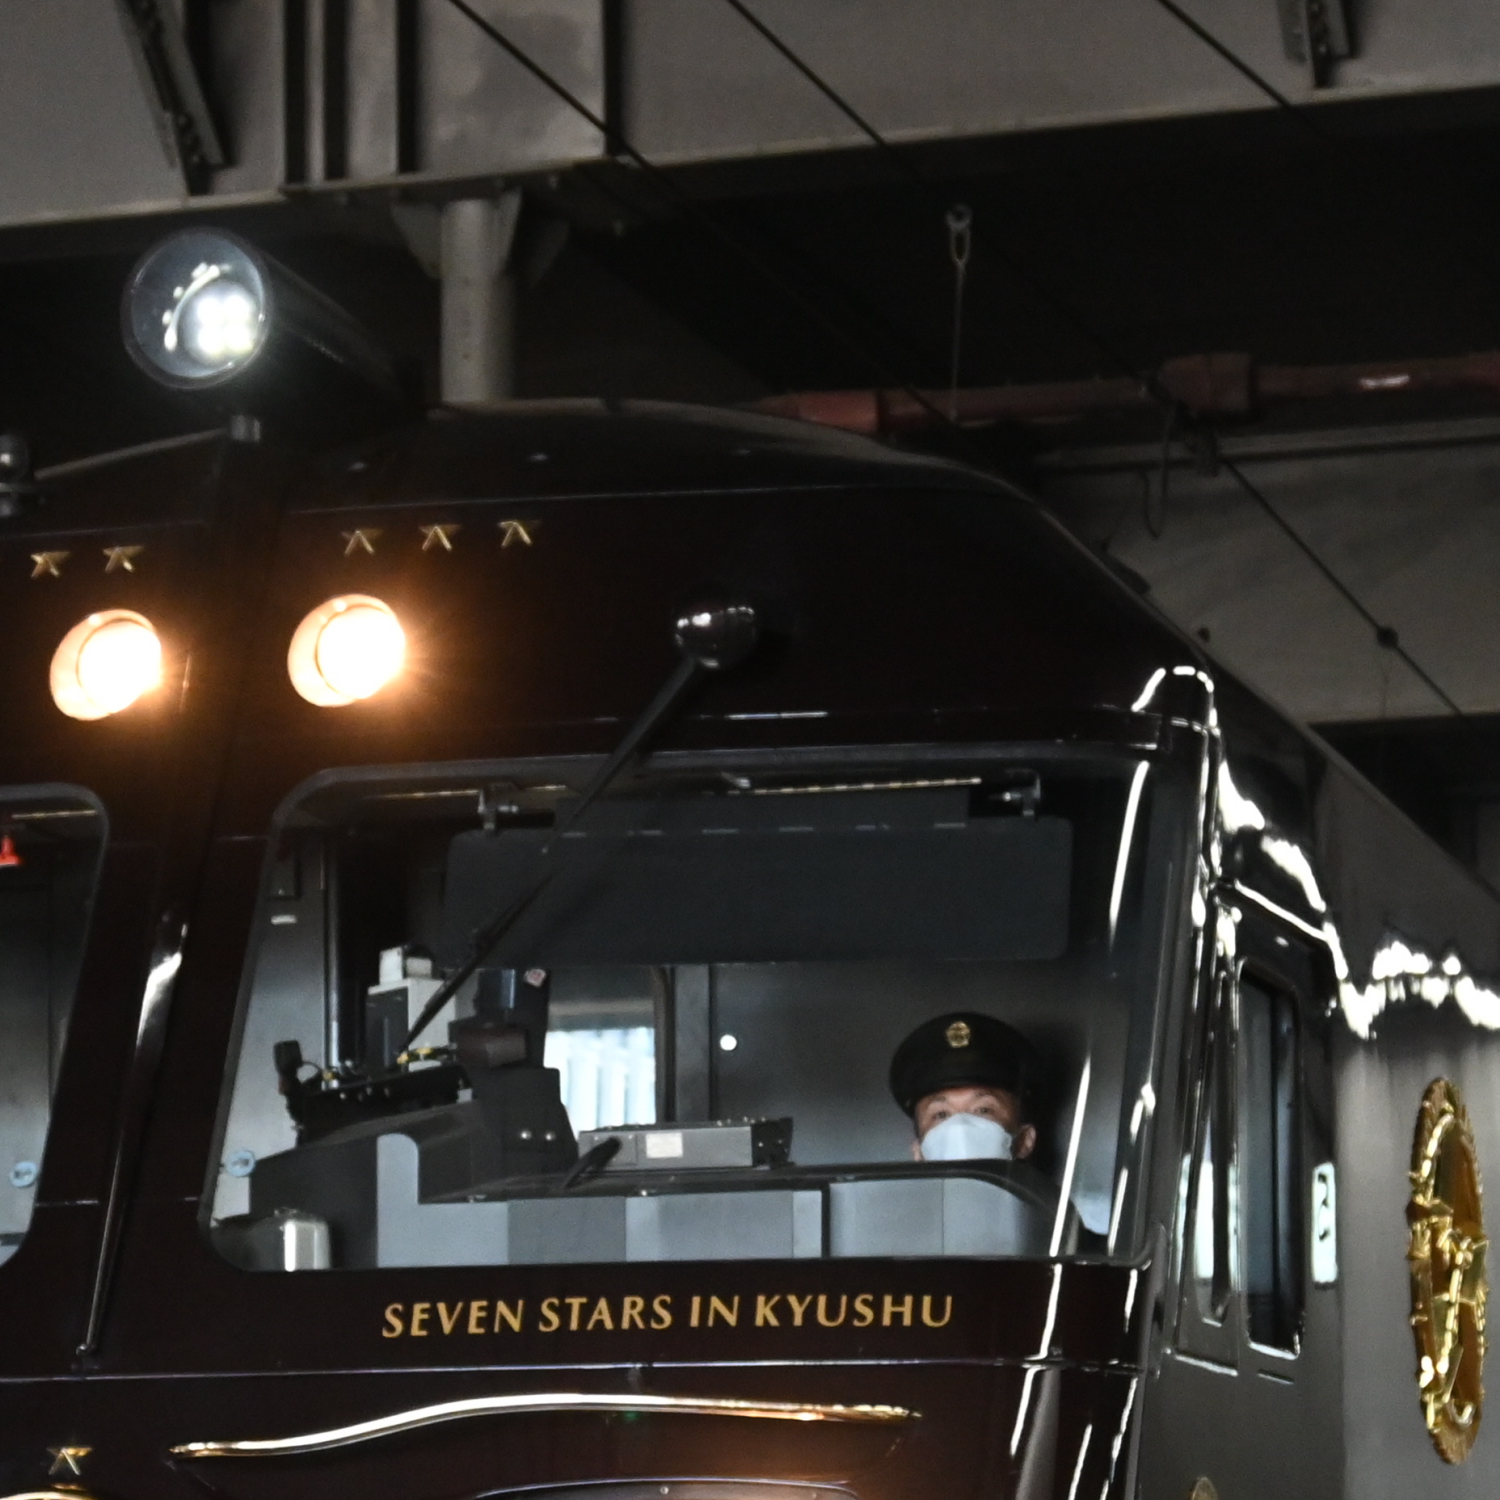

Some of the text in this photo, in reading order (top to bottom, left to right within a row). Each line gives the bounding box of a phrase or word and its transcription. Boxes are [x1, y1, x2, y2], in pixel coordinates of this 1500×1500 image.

[382, 1293, 953, 1338] SEVEN STARS IN KYUSHU
